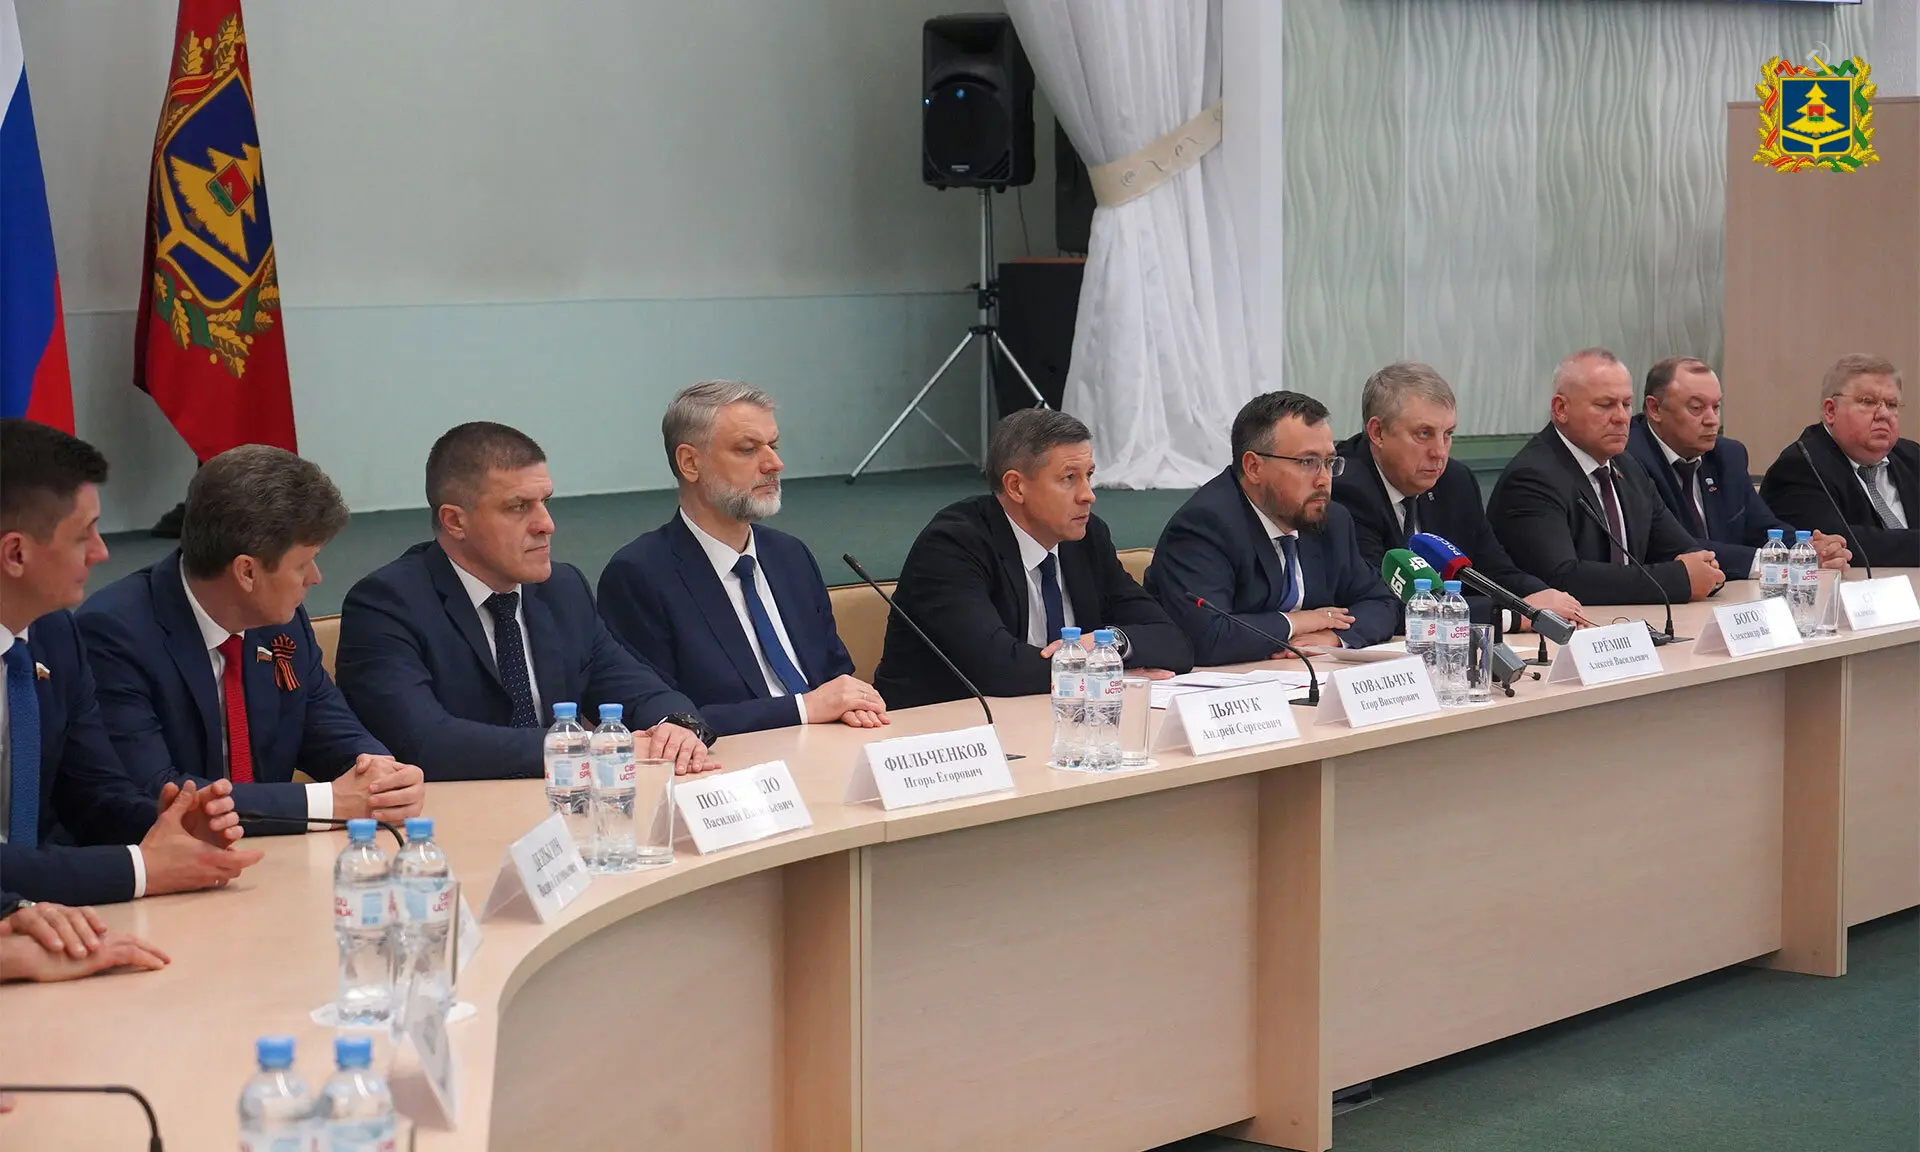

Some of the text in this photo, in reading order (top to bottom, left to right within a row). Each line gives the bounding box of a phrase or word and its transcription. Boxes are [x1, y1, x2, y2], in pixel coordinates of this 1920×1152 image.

[1591, 636, 1632, 654] ЕРЁМИН
[1613, 653, 1650, 666] Васильевич
[1351, 671, 1416, 695] КОВАЛЬЧУК
[1208, 696, 1262, 720] ДЬЯЧУК
[1360, 692, 1420, 711] Егор Викторович
[1202, 718, 1282, 740] Андрей Сергеевич
[884, 742, 988, 772] ФИЛЬЧЕНКОВ
[903, 767, 983, 789] Игорь Егорович
[702, 807, 743, 830] Василий
